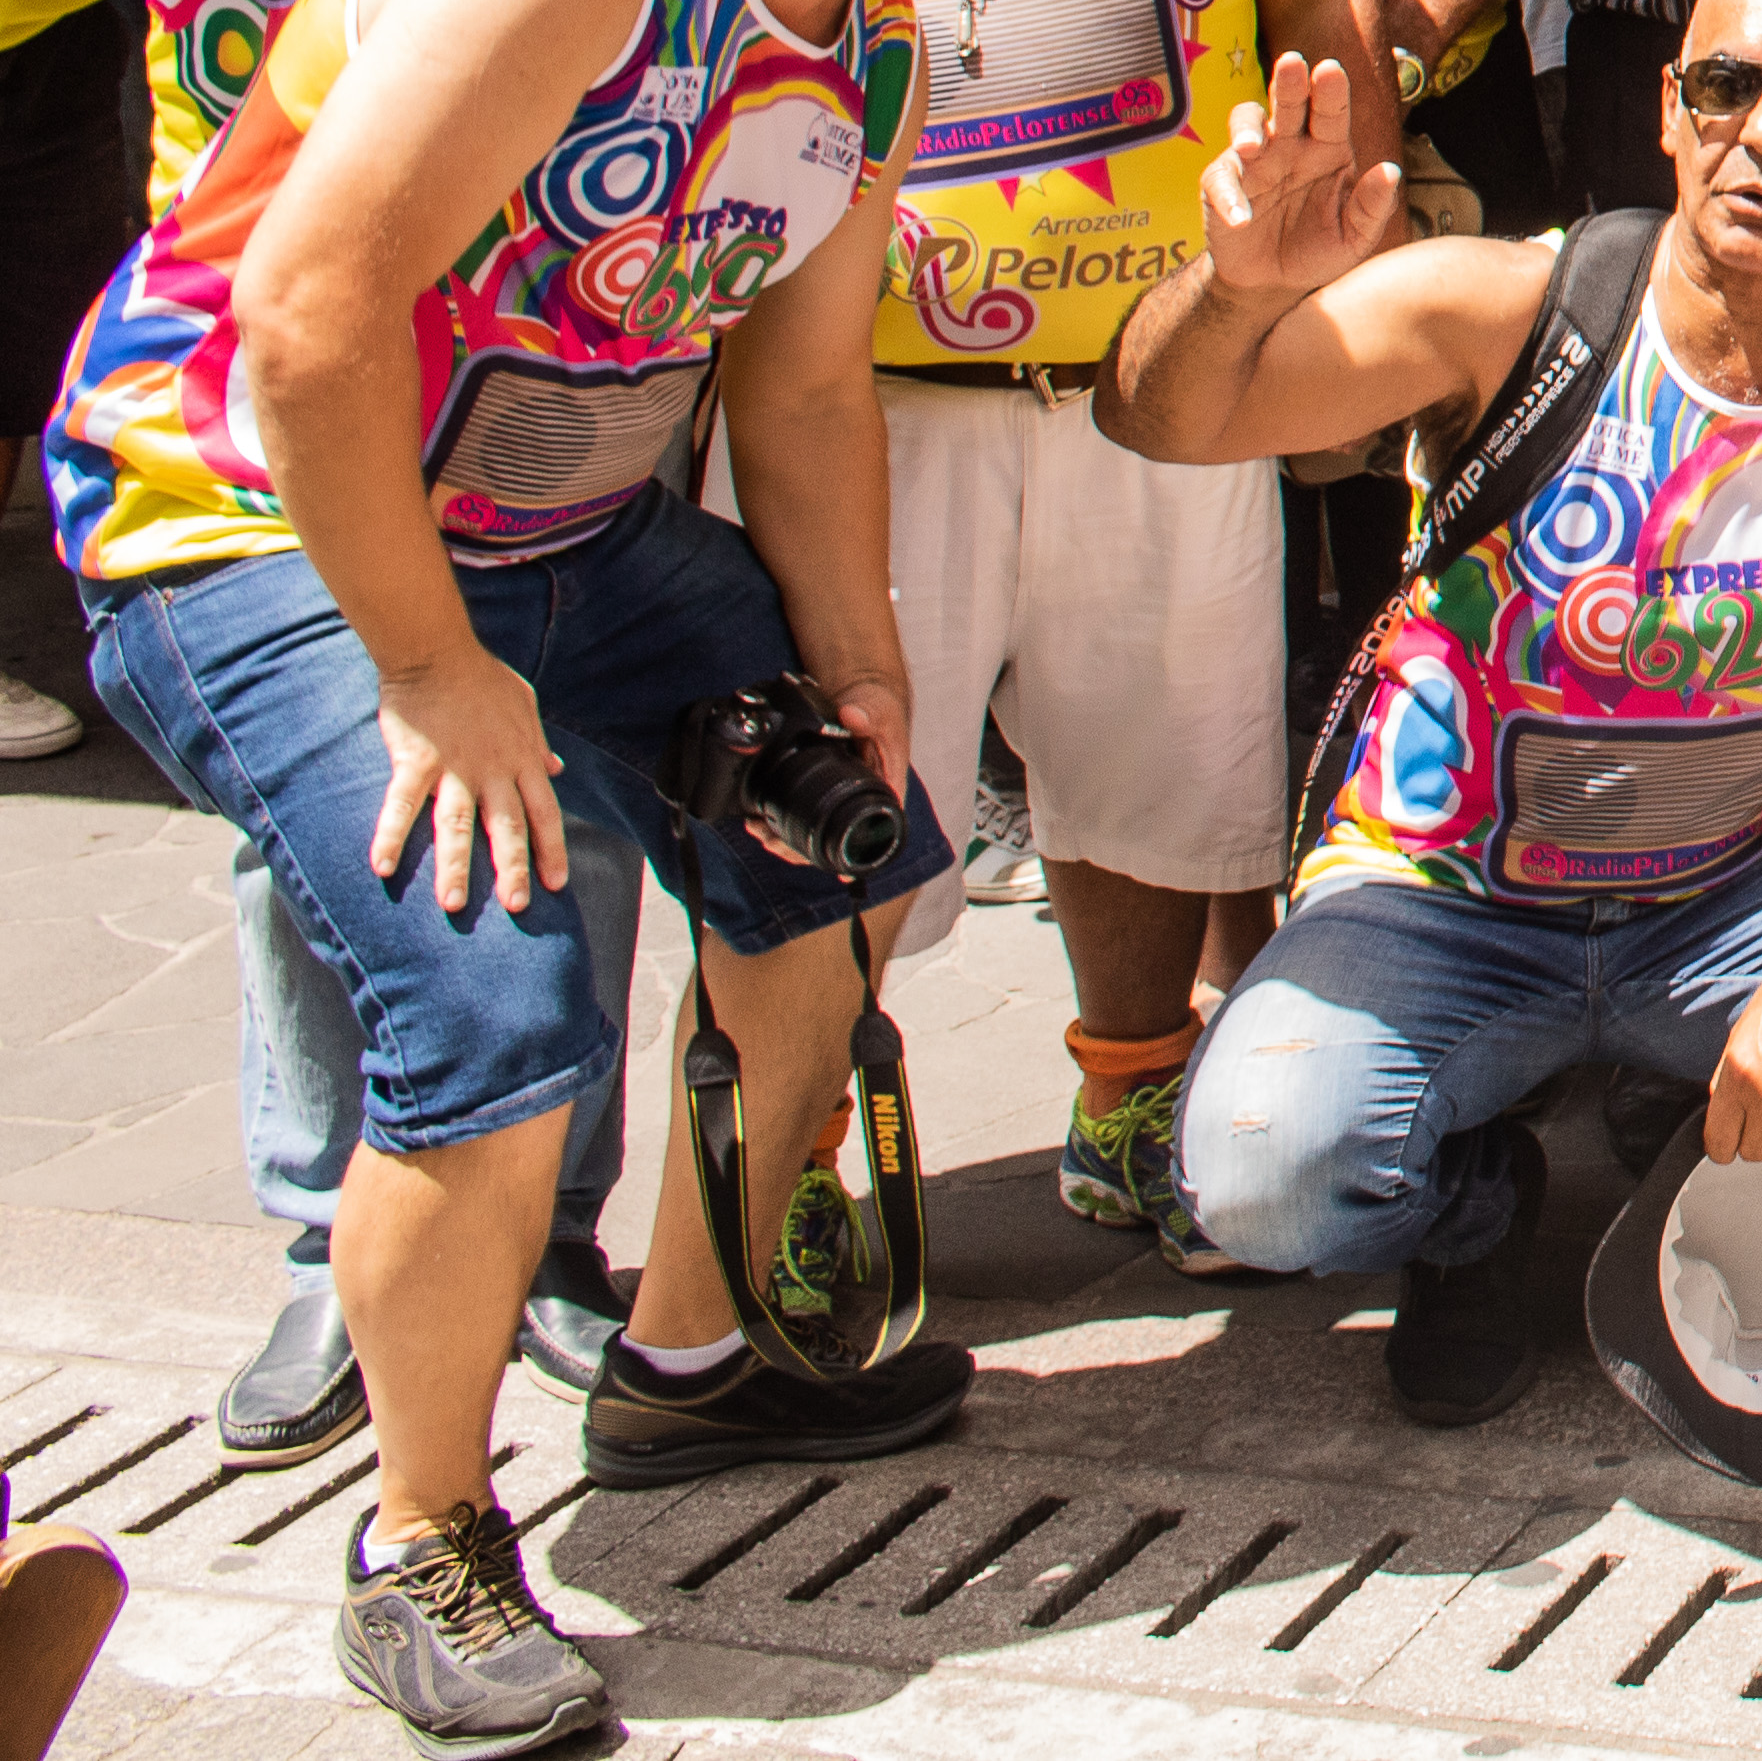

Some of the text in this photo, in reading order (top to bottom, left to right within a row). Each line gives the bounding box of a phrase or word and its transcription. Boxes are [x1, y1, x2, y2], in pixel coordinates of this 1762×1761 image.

[1029, 207, 1151, 238] Arrozeira
[981, 239, 1189, 293] Pelotas
[871, 1093, 900, 1174] Nikon
